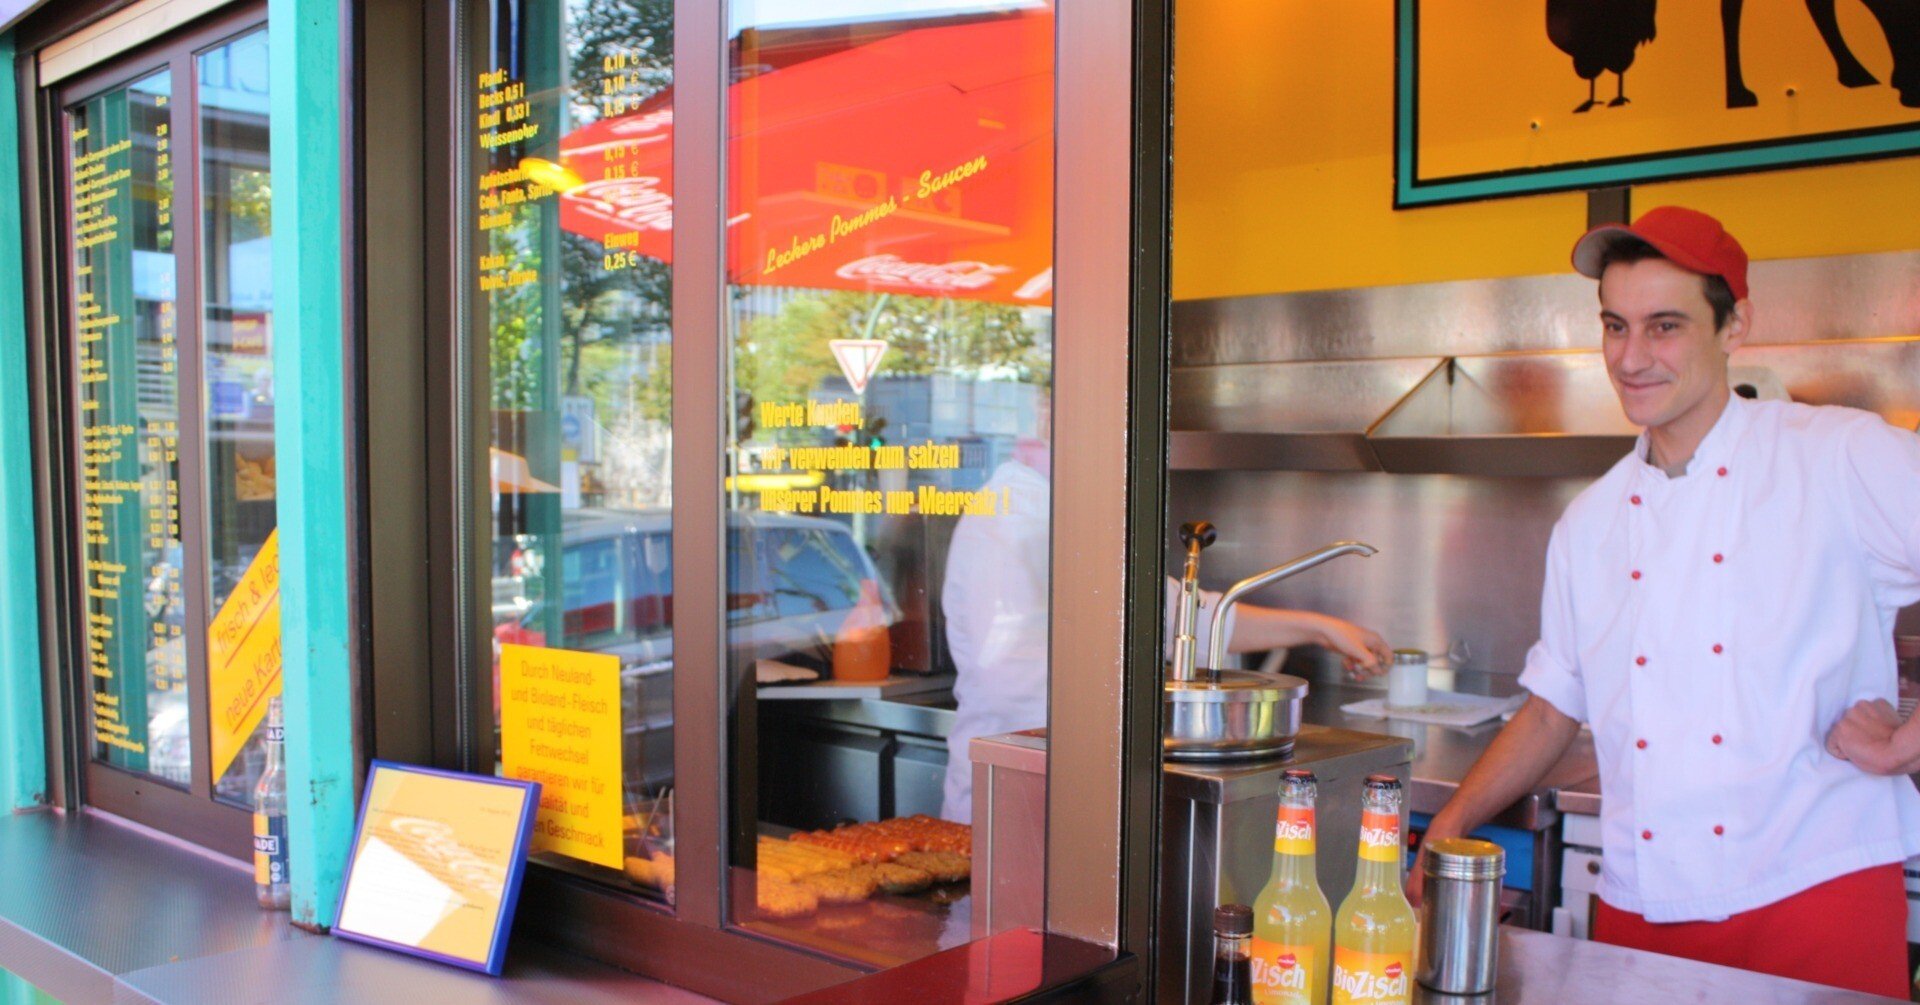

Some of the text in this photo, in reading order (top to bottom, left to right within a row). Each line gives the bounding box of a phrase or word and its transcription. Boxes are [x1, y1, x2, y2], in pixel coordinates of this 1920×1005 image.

[830, 196, 897, 243] Pommes
[917, 154, 987, 199] Saucen
[761, 398, 864, 429] Werte Kunden,
[789, 441, 870, 470] verwenden
[874, 445, 904, 469] zum
[908, 440, 959, 469] salzen
[760, 487, 818, 513] unserer
[820, 486, 883, 514] Pommes
[886, 490, 915, 516] nur
[918, 485, 998, 516] Meersalz
[224, 634, 284, 727] neue Kart
[521, 660, 549, 680] Durch
[511, 687, 528, 703] und
[527, 716, 592, 740] und täglichen
[529, 738, 589, 765] Fettwechsel
[572, 776, 588, 793] wir
[590, 777, 605, 795] für
[539, 796, 590, 819] ualität und
[547, 819, 604, 849] Geschmack
[1250, 957, 1305, 990] Zisch
[1333, 964, 1407, 1000] BioZisch
